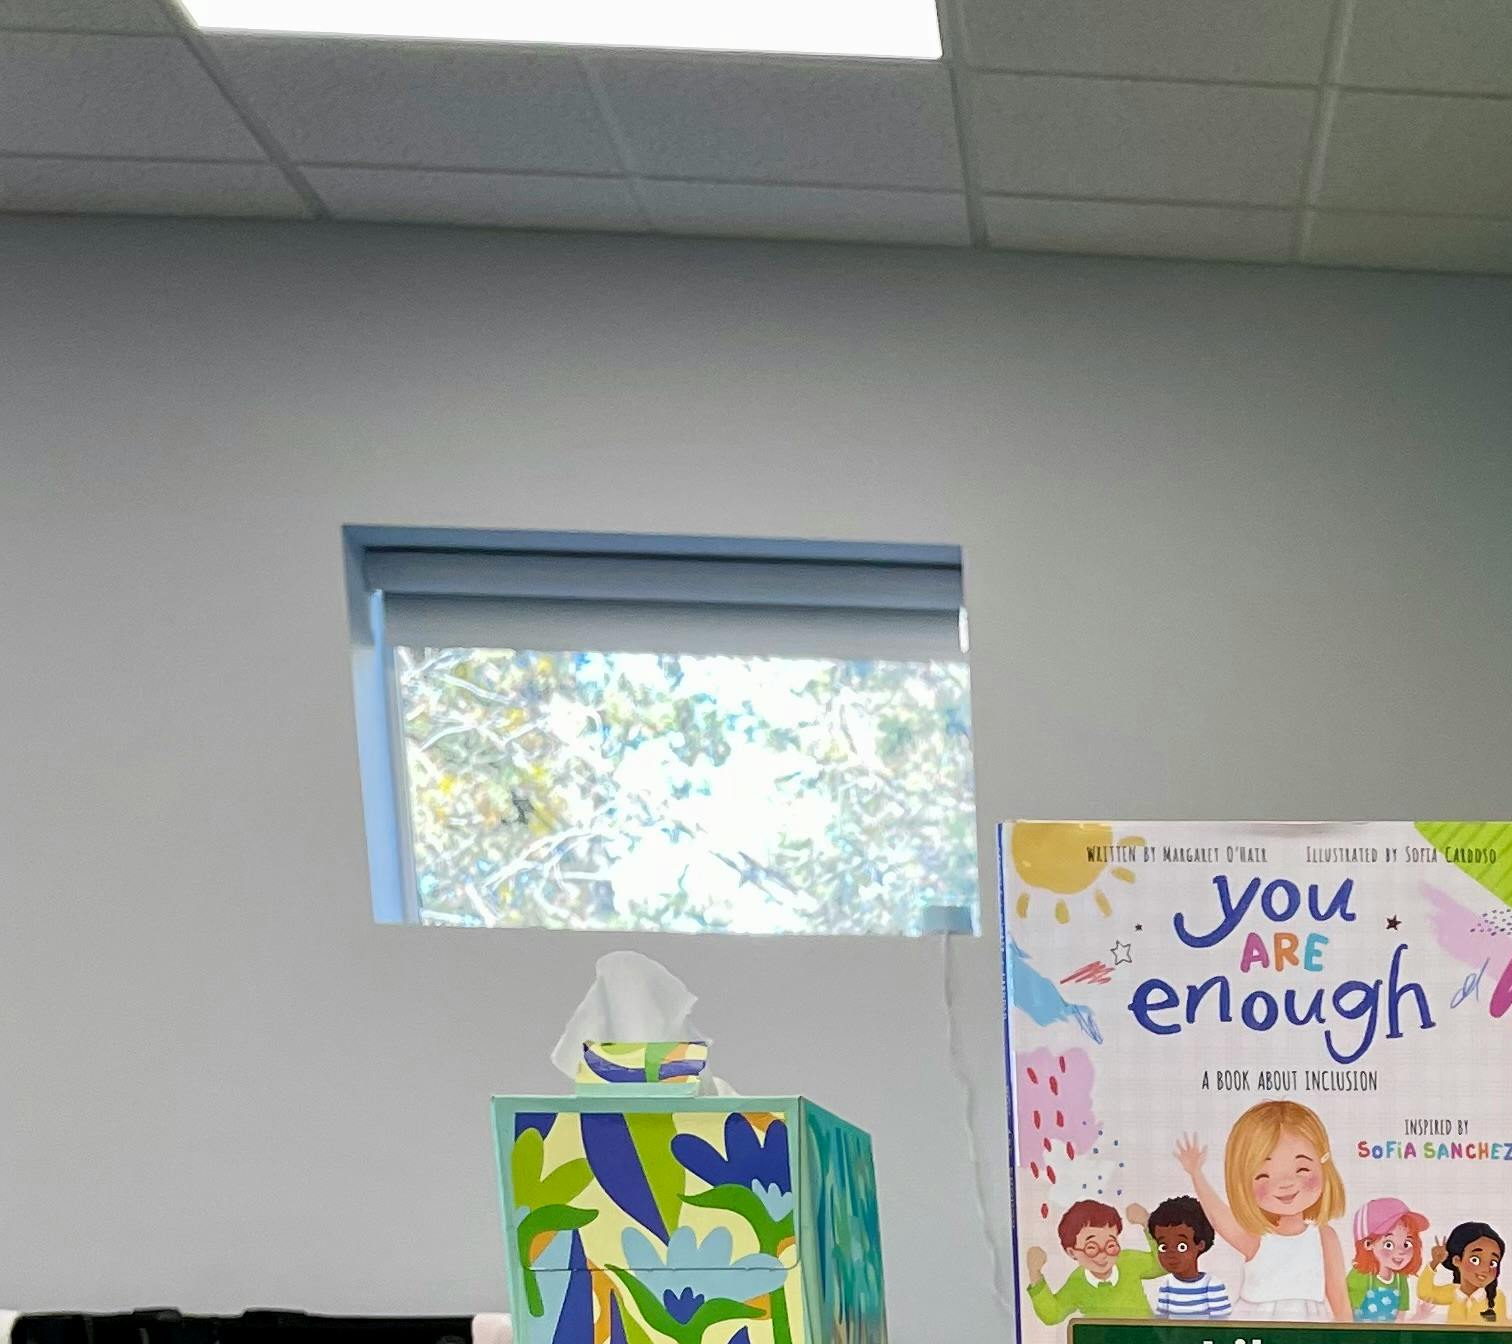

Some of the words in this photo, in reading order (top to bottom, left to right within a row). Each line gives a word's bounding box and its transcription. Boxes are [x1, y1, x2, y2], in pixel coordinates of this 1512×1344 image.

[1143, 847, 1157, 863] BY
[1385, 848, 1398, 863] BY
[1172, 874, 1357, 949] you
[1240, 932, 1330, 973] ARE
[1127, 943, 1436, 1065] enough
[1202, 1071, 1210, 1090] A
[1216, 1070, 1251, 1091] BOOK
[1257, 1070, 1298, 1091] ABOUT
[1305, 1070, 1377, 1092] INCLUSION
[1404, 1119, 1452, 1136] INSPIRED
[1457, 1119, 1469, 1136] BY
